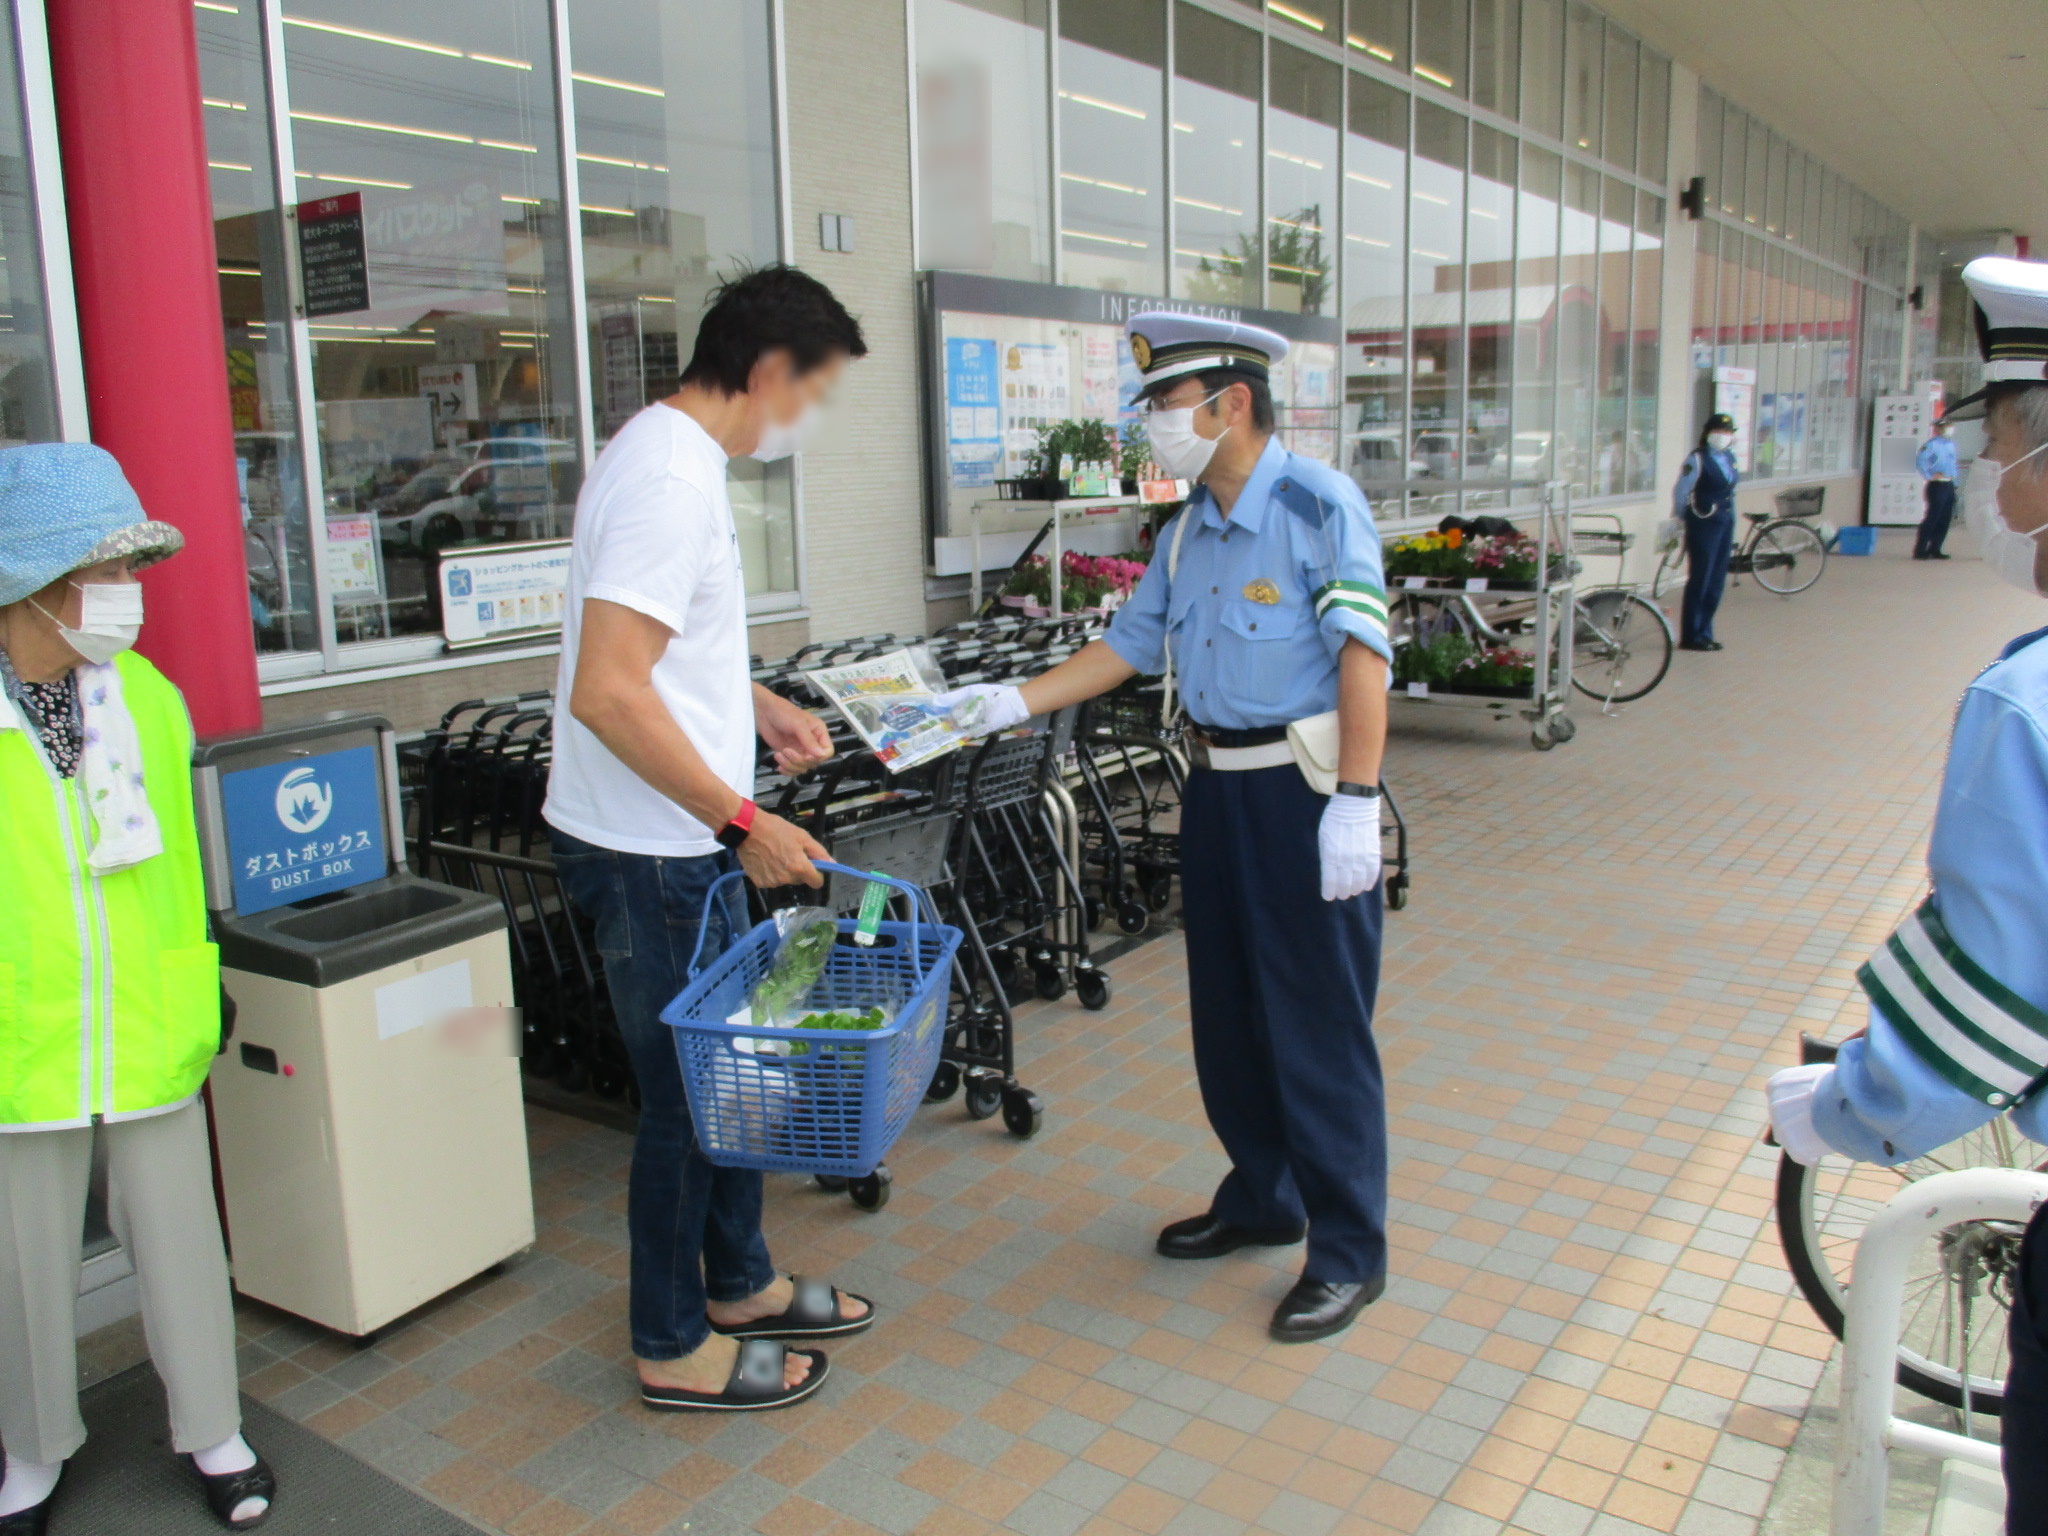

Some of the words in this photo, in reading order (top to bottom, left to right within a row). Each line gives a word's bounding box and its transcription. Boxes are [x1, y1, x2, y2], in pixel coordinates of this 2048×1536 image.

[245, 830, 371, 877] ダストボックス
[271, 869, 311, 890] DUST
[322, 858, 353, 876] BOX
